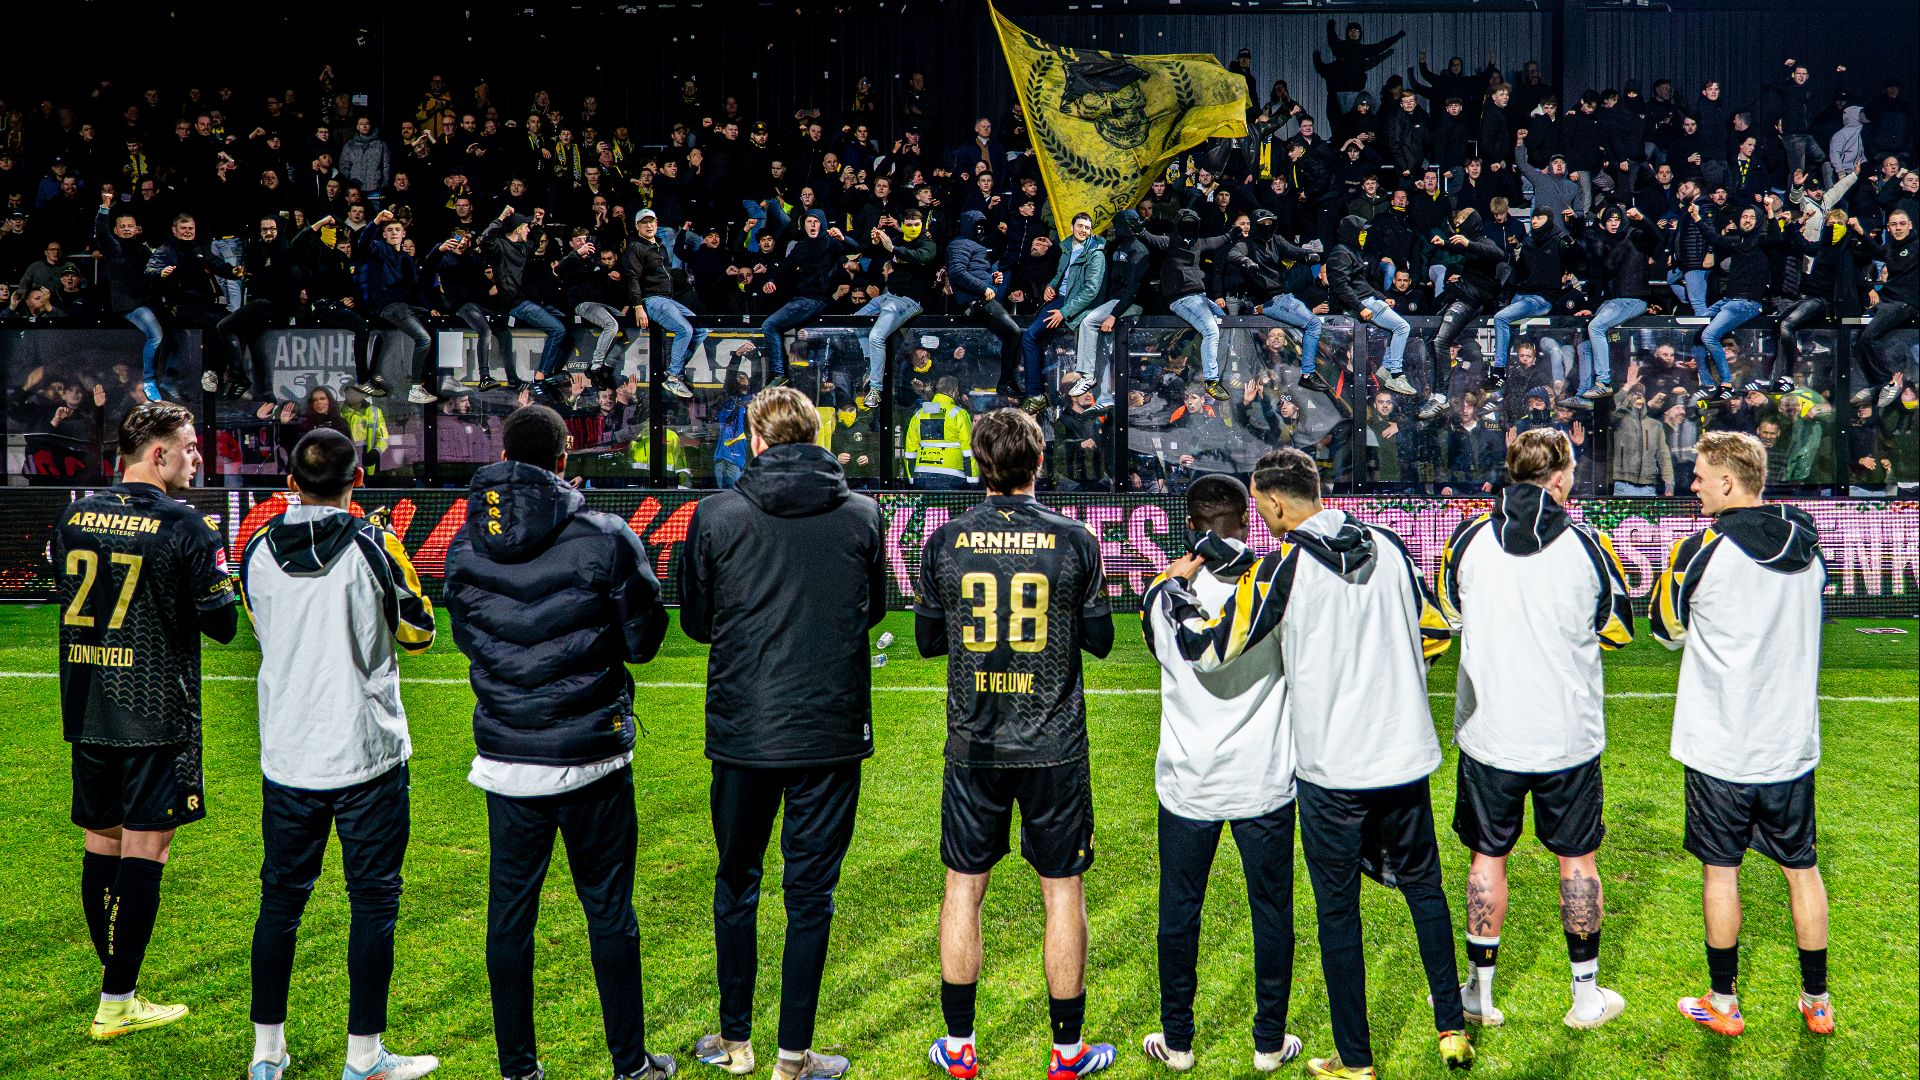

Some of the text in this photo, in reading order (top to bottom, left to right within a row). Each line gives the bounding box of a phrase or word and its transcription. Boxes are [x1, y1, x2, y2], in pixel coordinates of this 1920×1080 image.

[67, 511, 161, 534] ARNHEM
[81, 526, 136, 537] ACHTER VITESSE
[954, 531, 1057, 550] ARNHEM
[973, 547, 1002, 555] ACHTER
[64, 549, 144, 630] 27
[961, 572, 1050, 653] 38
[67, 643, 134, 668] ZONNEVELD
[974, 671, 1034, 694] TE VELUWE
